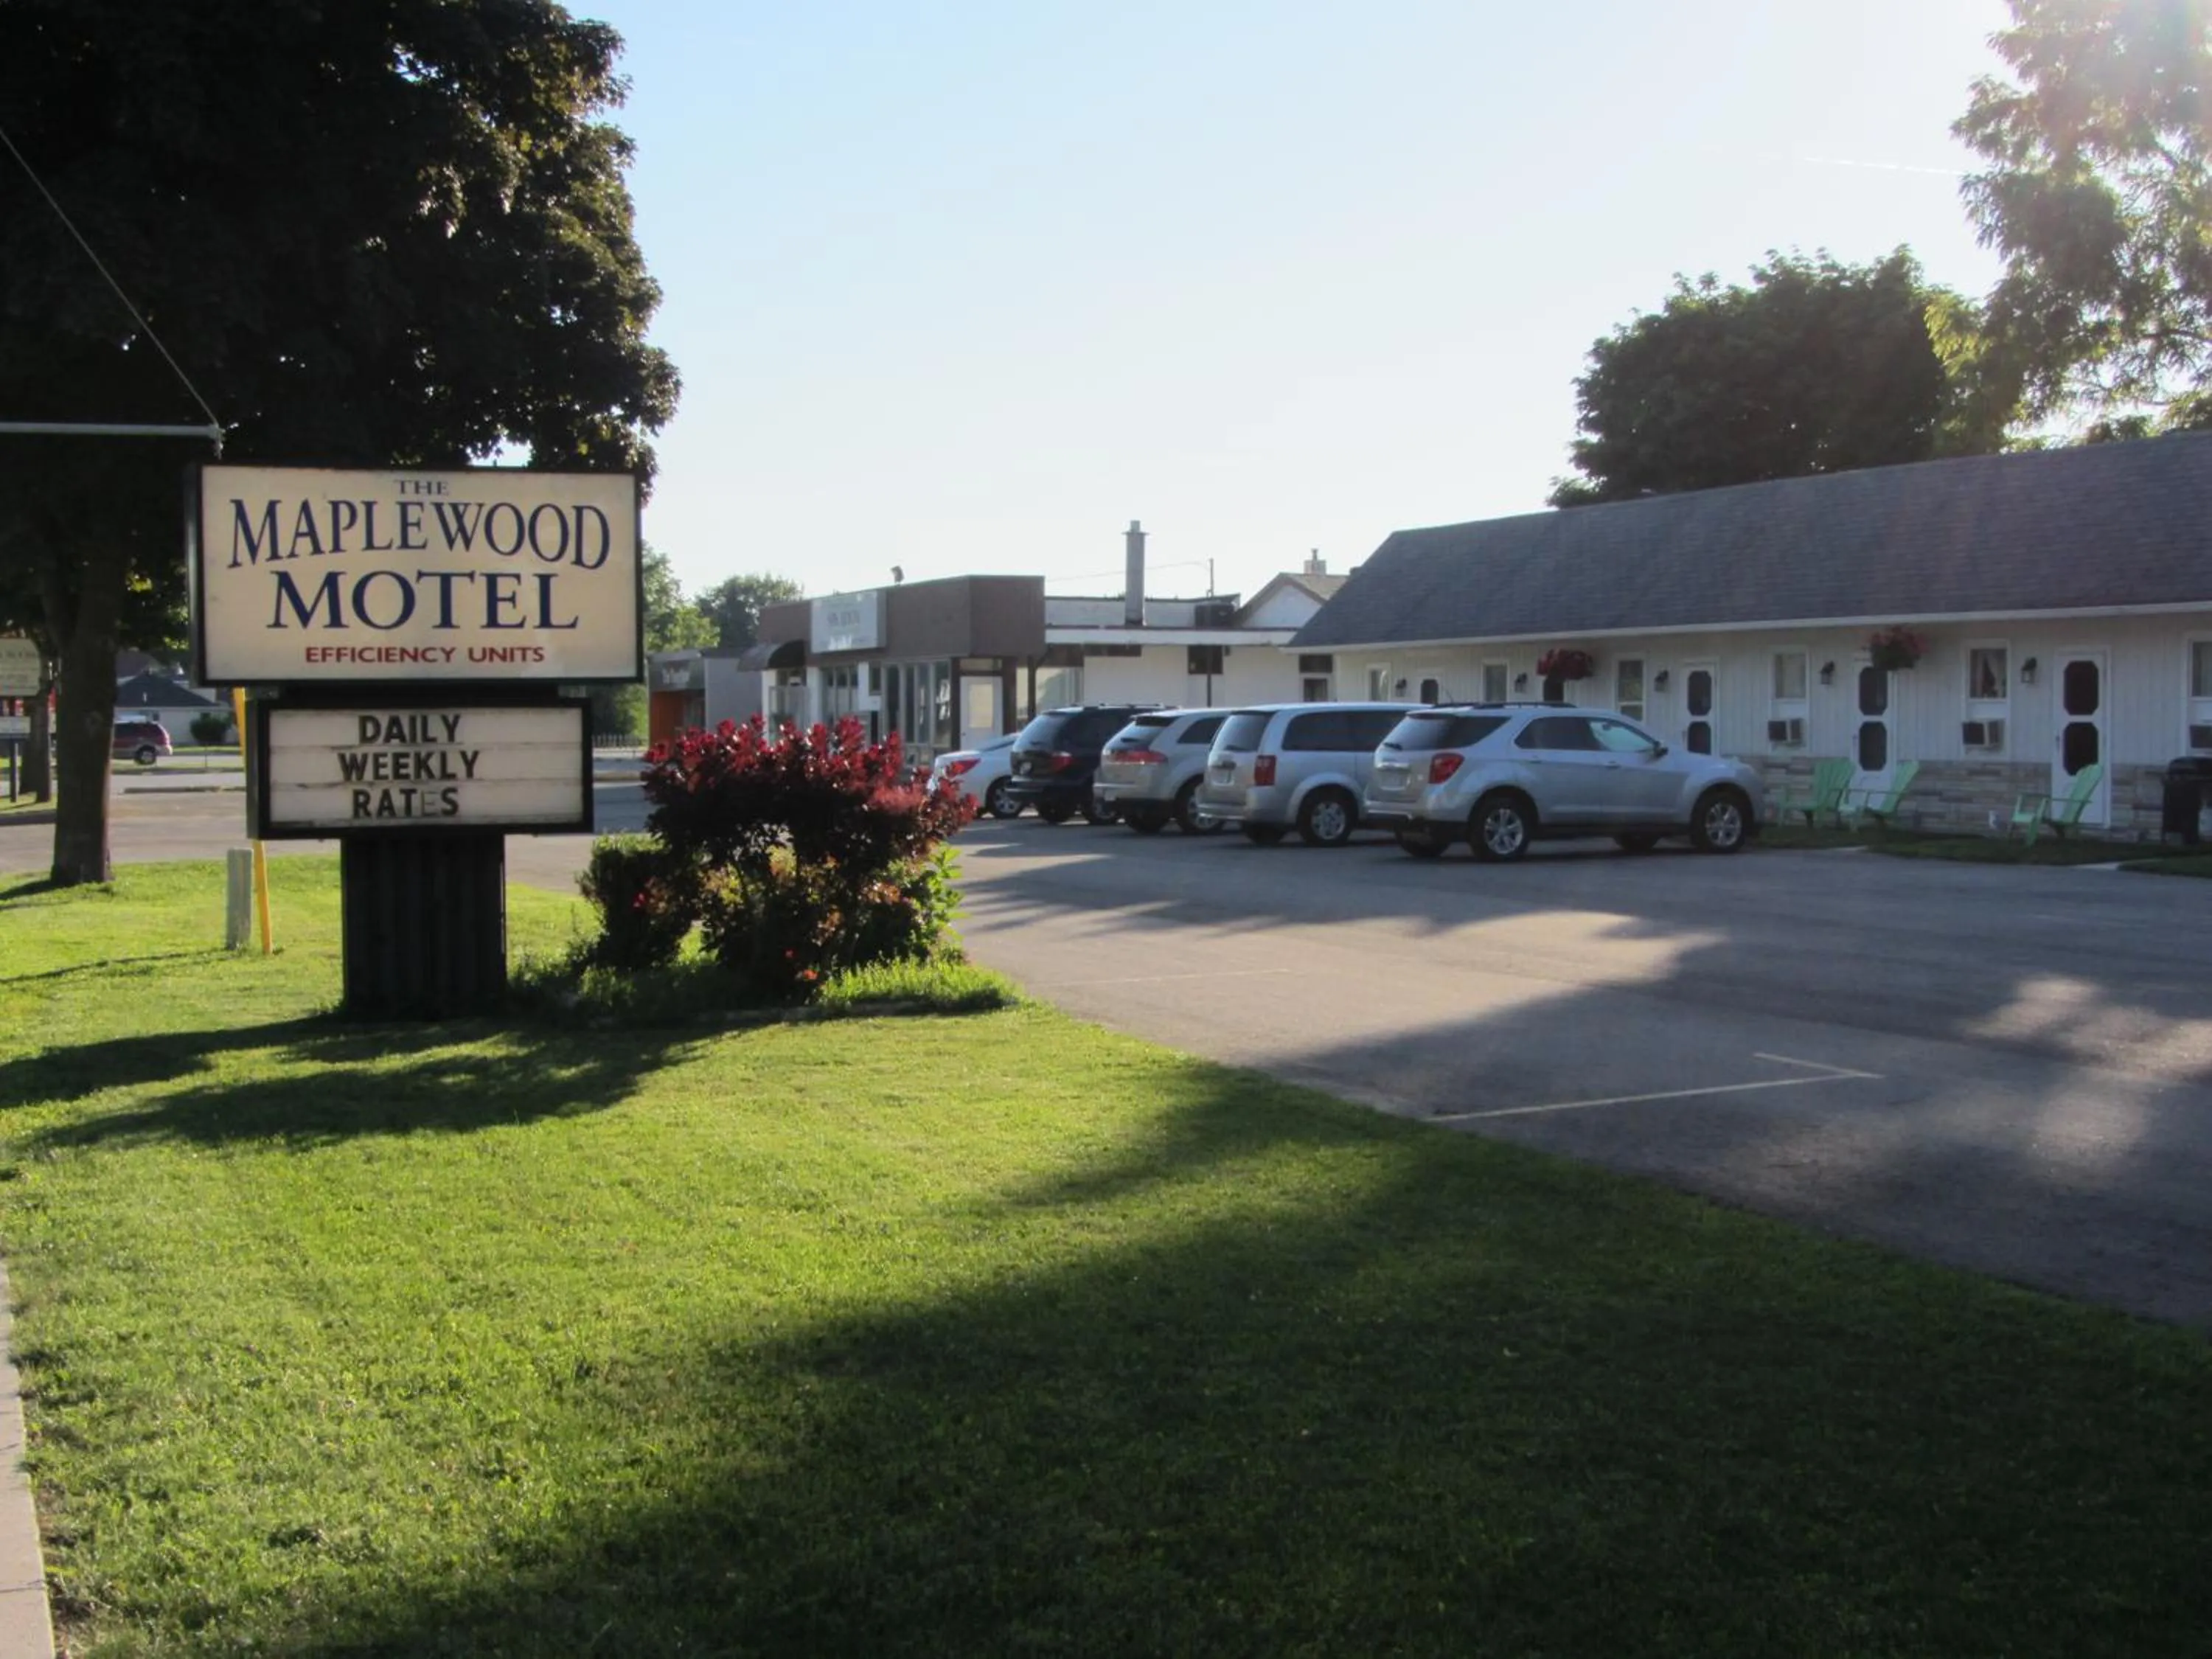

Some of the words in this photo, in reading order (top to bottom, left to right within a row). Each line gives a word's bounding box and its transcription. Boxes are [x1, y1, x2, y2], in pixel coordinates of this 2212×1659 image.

[394, 479, 449, 495] THE
[227, 498, 611, 571] MAPLEWOOD
[266, 570, 580, 630] MOTEL
[305, 646, 457, 664] EFFICIENCY
[467, 646, 546, 663] UNITS
[358, 714, 462, 745] DAILY
[338, 750, 480, 782] WEEKLY
[352, 787, 459, 819] RATES
